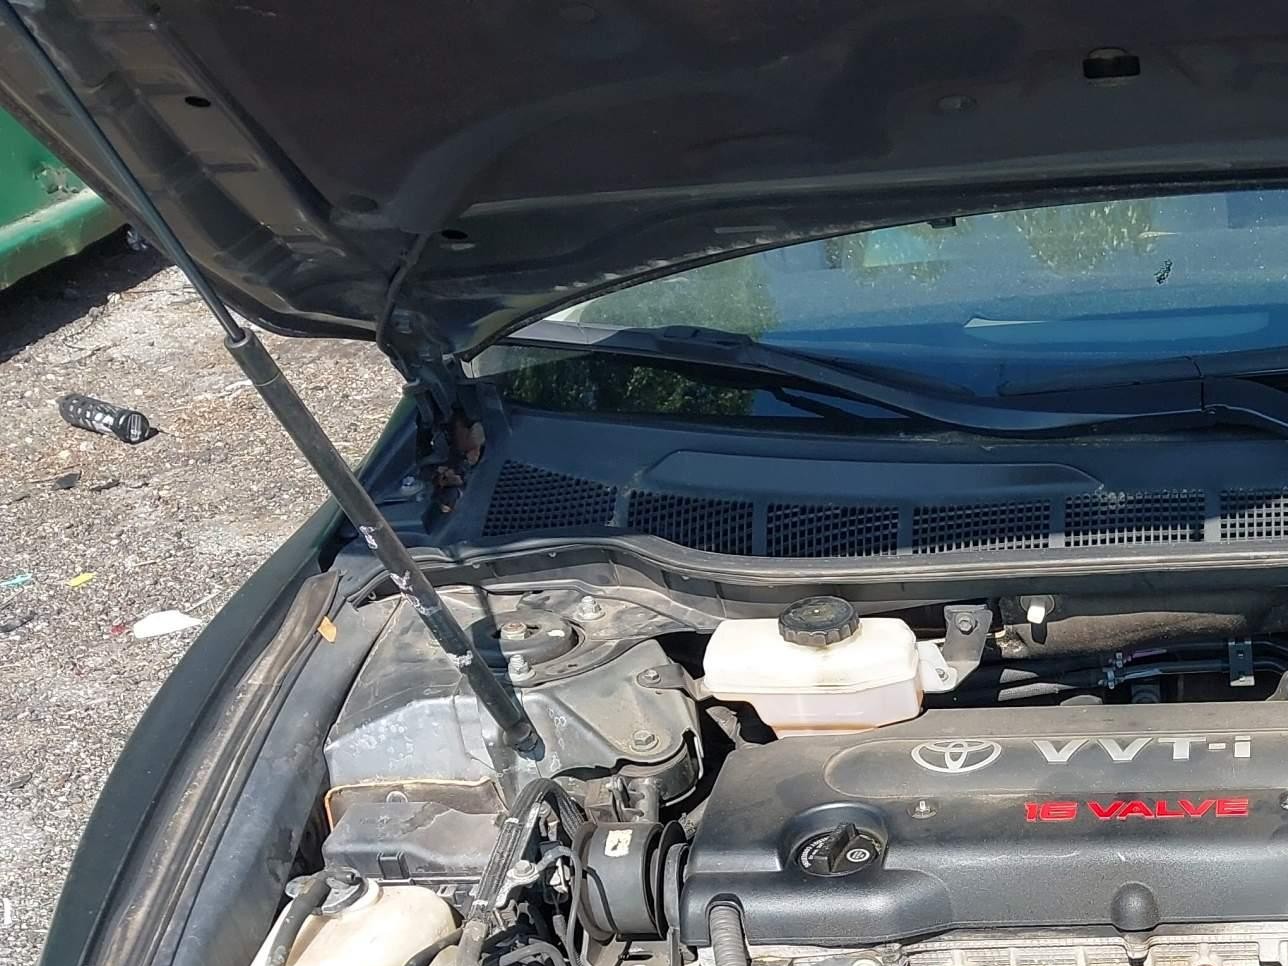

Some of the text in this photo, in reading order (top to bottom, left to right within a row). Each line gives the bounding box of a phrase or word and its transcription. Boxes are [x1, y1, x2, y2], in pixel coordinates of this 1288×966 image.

[1033, 735, 1251, 764] VVT-i
[1024, 797, 1250, 823] 16 VALVE
